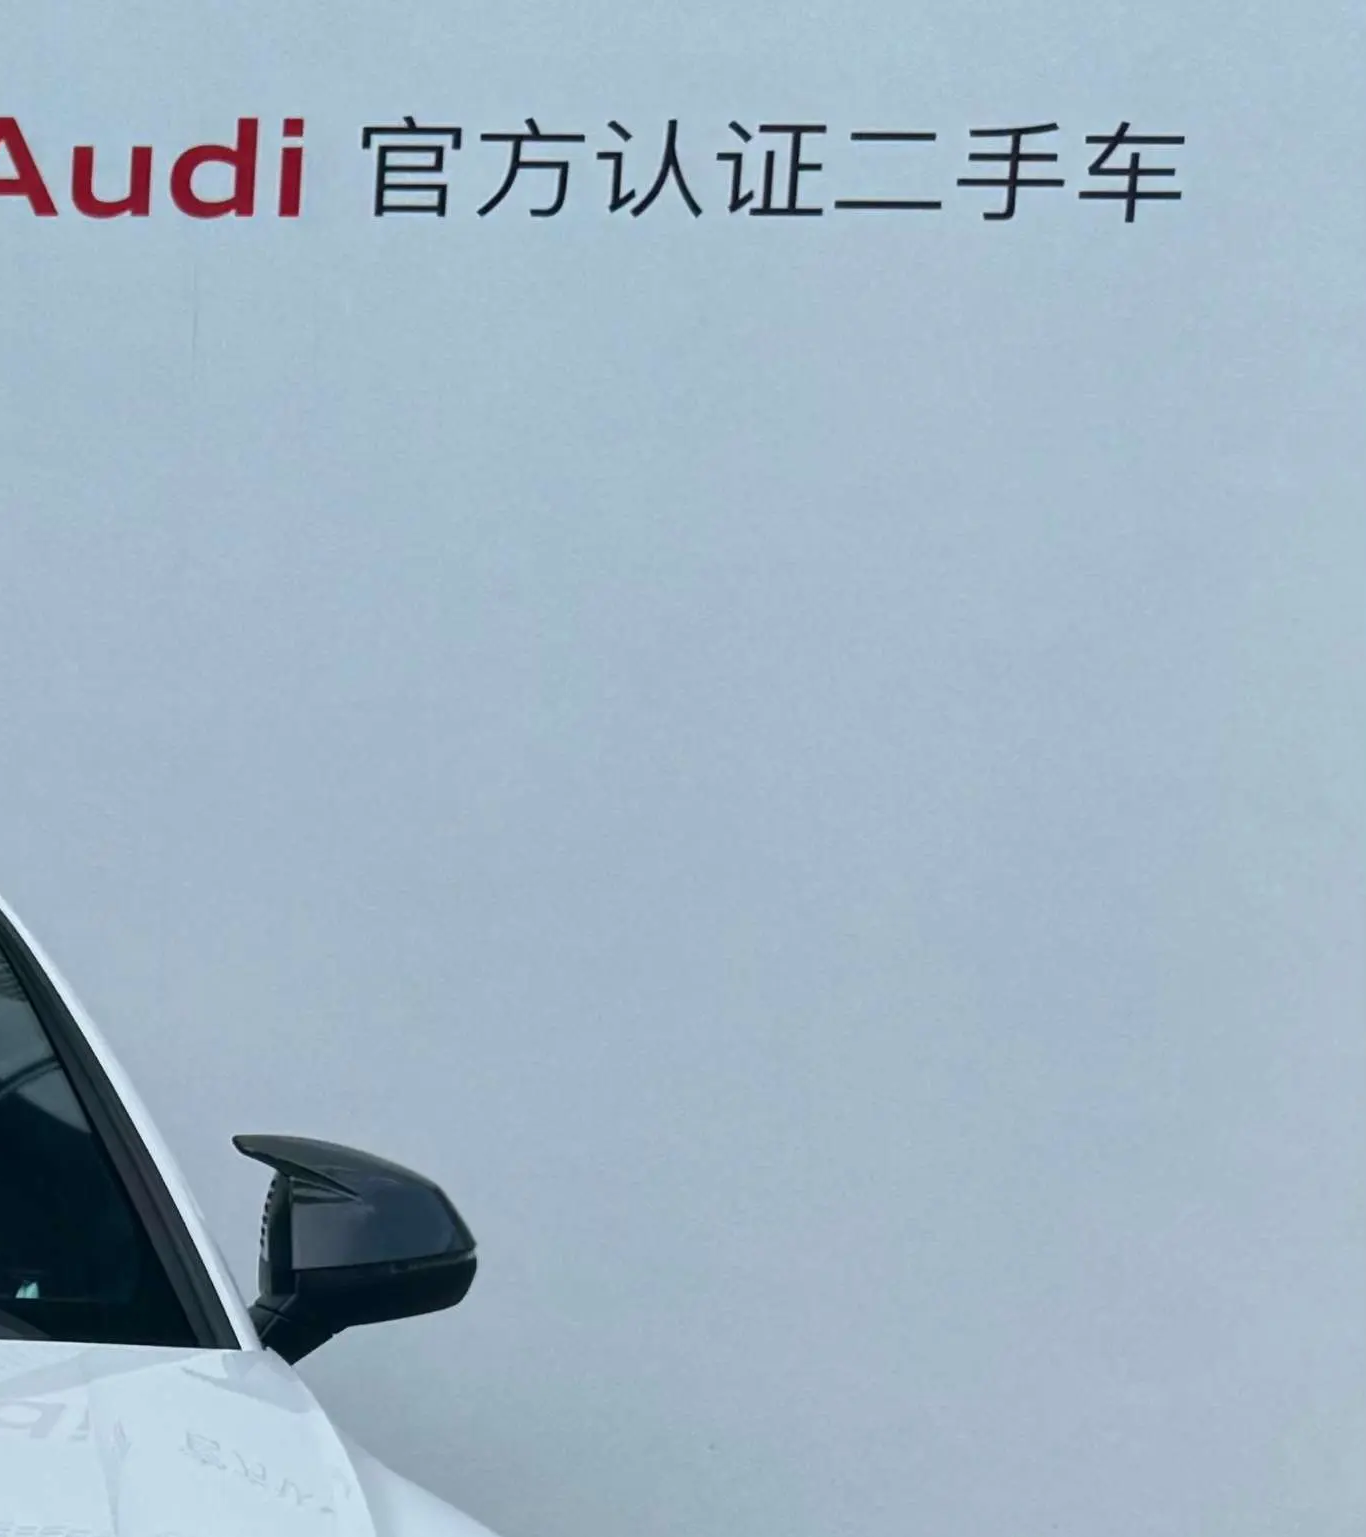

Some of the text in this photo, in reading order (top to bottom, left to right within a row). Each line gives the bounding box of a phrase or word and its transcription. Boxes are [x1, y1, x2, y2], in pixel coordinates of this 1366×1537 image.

[362, 116, 1185, 223] 官方认证二手车
